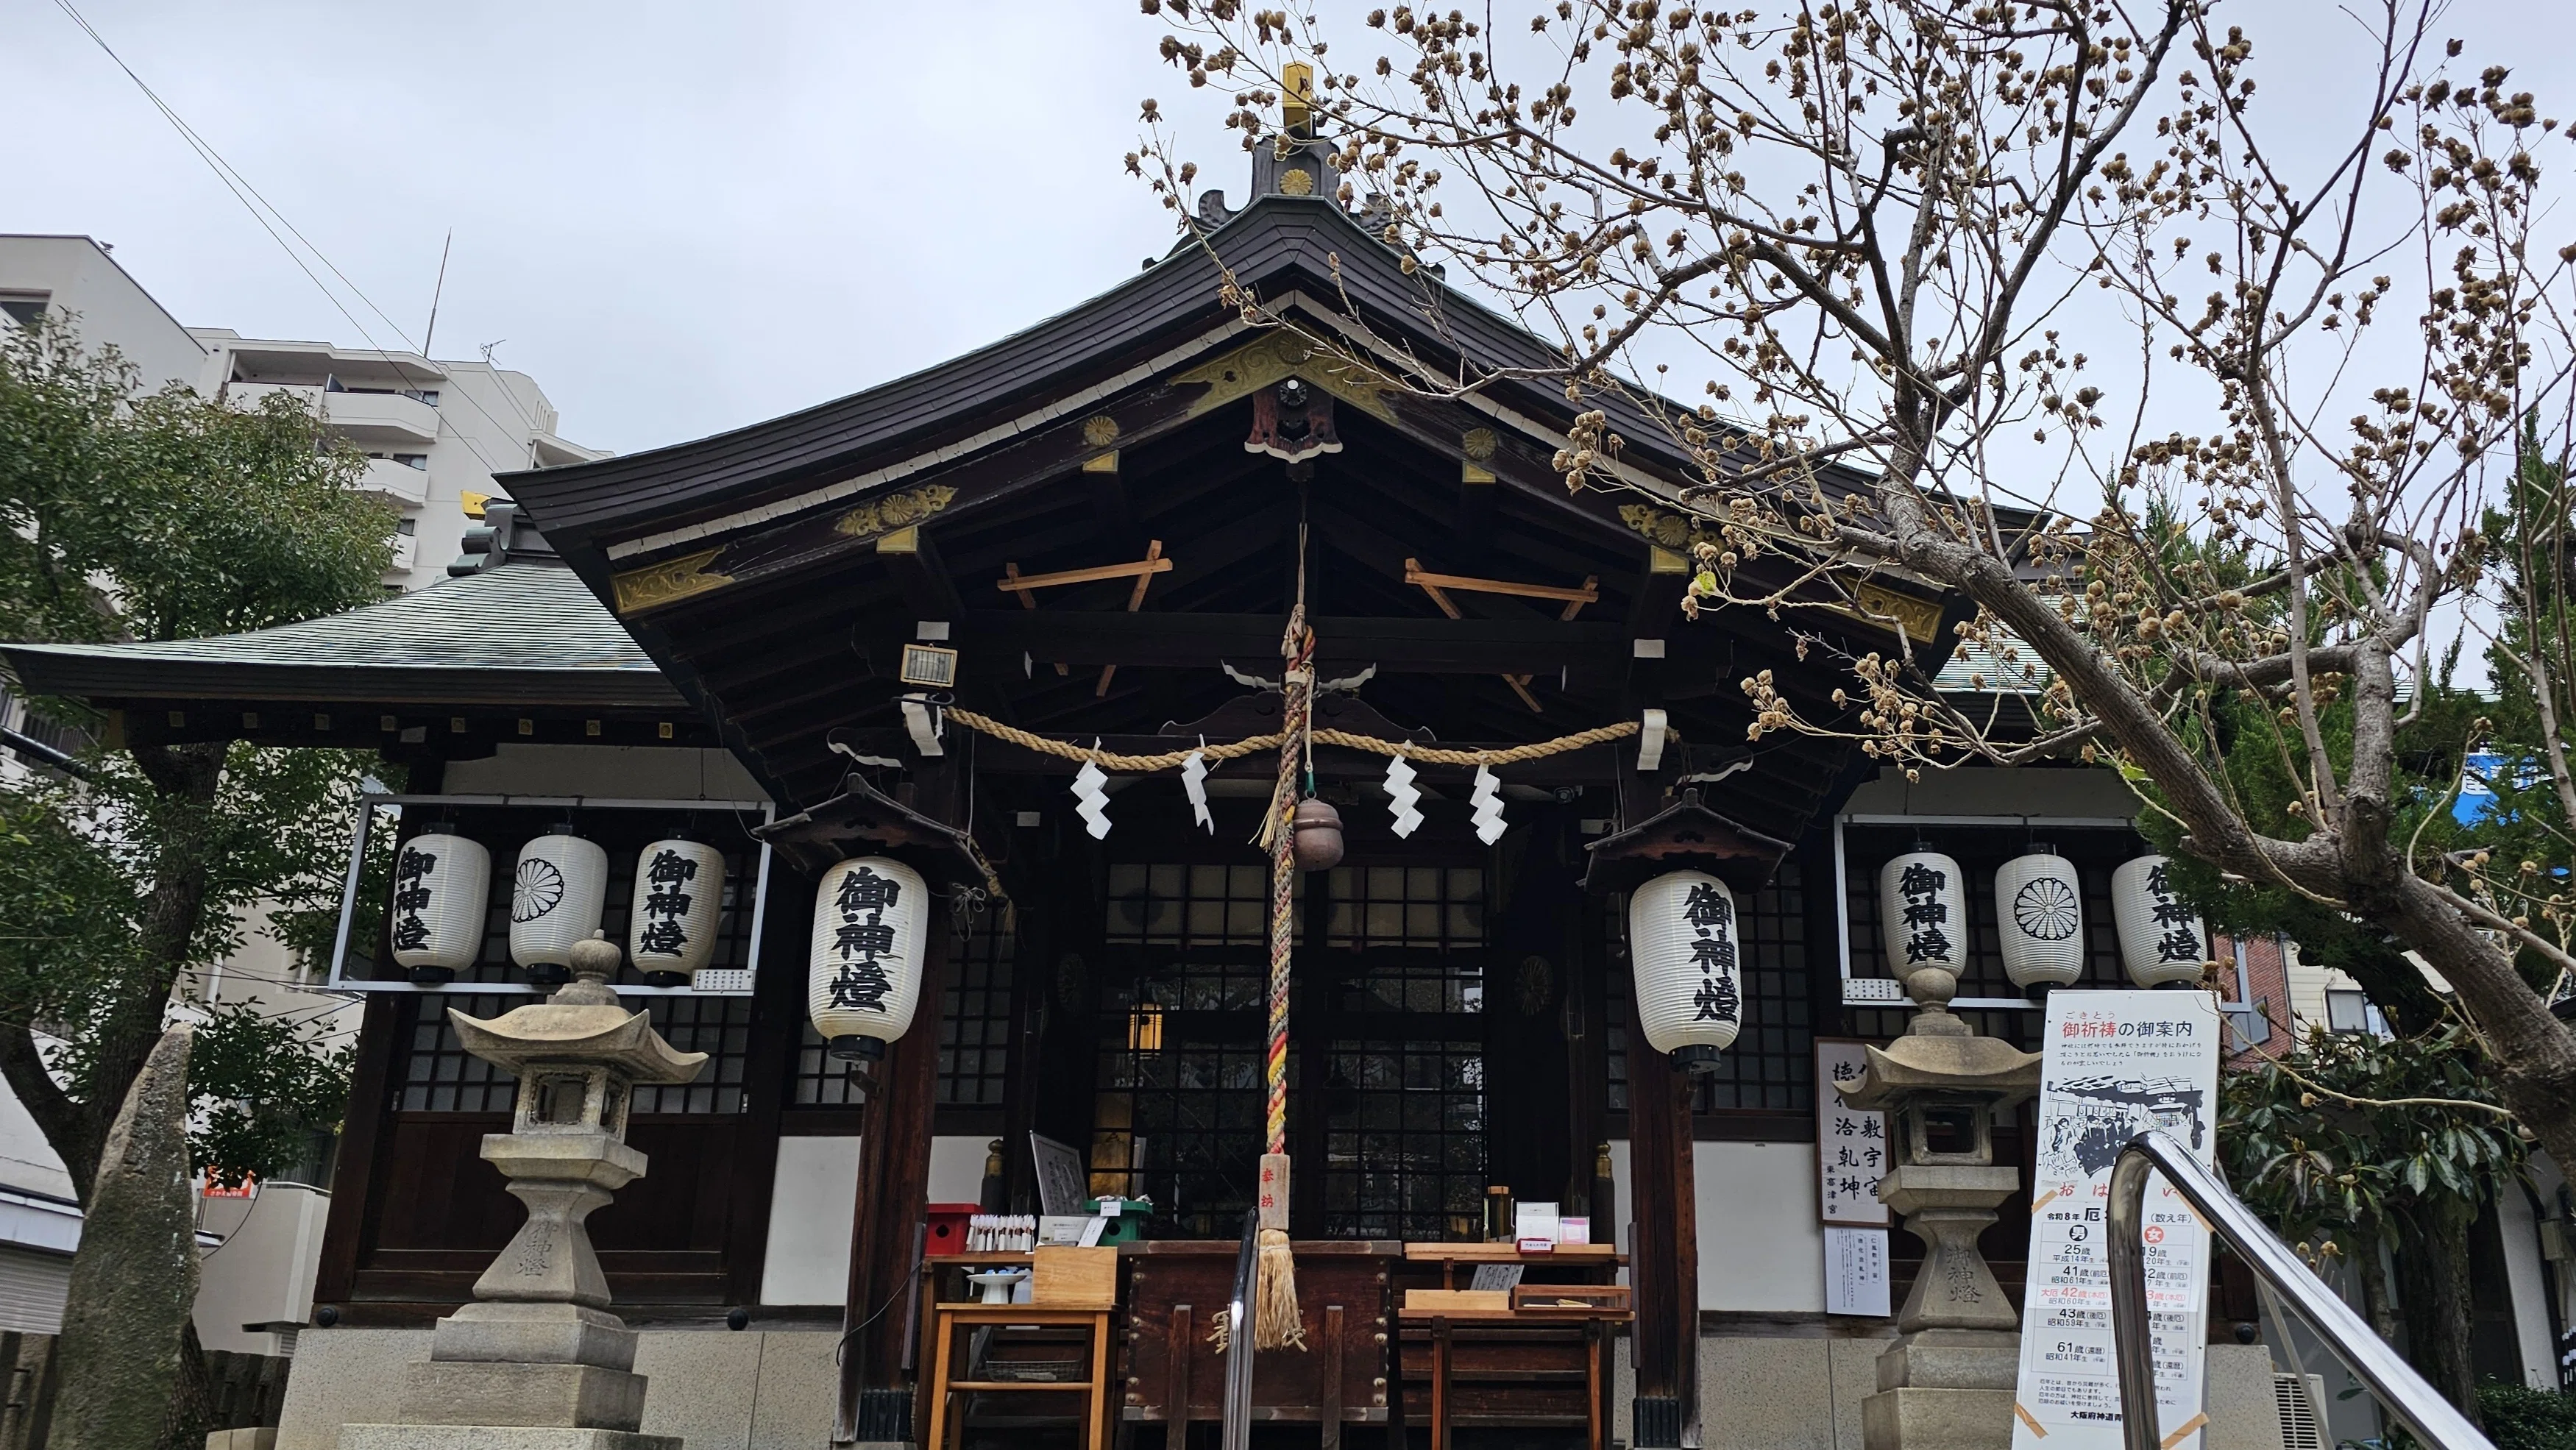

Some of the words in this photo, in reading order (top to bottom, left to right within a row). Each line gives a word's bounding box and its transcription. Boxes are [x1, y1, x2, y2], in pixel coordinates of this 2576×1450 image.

[639, 849, 699, 957] 御神燈
[1898, 862, 1952, 964] 御神燈
[827, 866, 901, 1013] 御神燈
[1682, 882, 1739, 1026] 御神燈
[2062, 1020, 2192, 1038] 御祈祷の御案内
[2065, 1011, 2115, 1020] ごきとう
[1261, 1168, 1274, 1208] 奉納
[2047, 1212, 2080, 1220] 令和8年
[2071, 1226, 2086, 1240] 男
[2146, 1227, 2163, 1242] 女
[514, 1221, 559, 1276] 御神燈
[2065, 1244, 2090, 1255] 25歳
[1947, 1245, 1985, 1304] 御神燈
